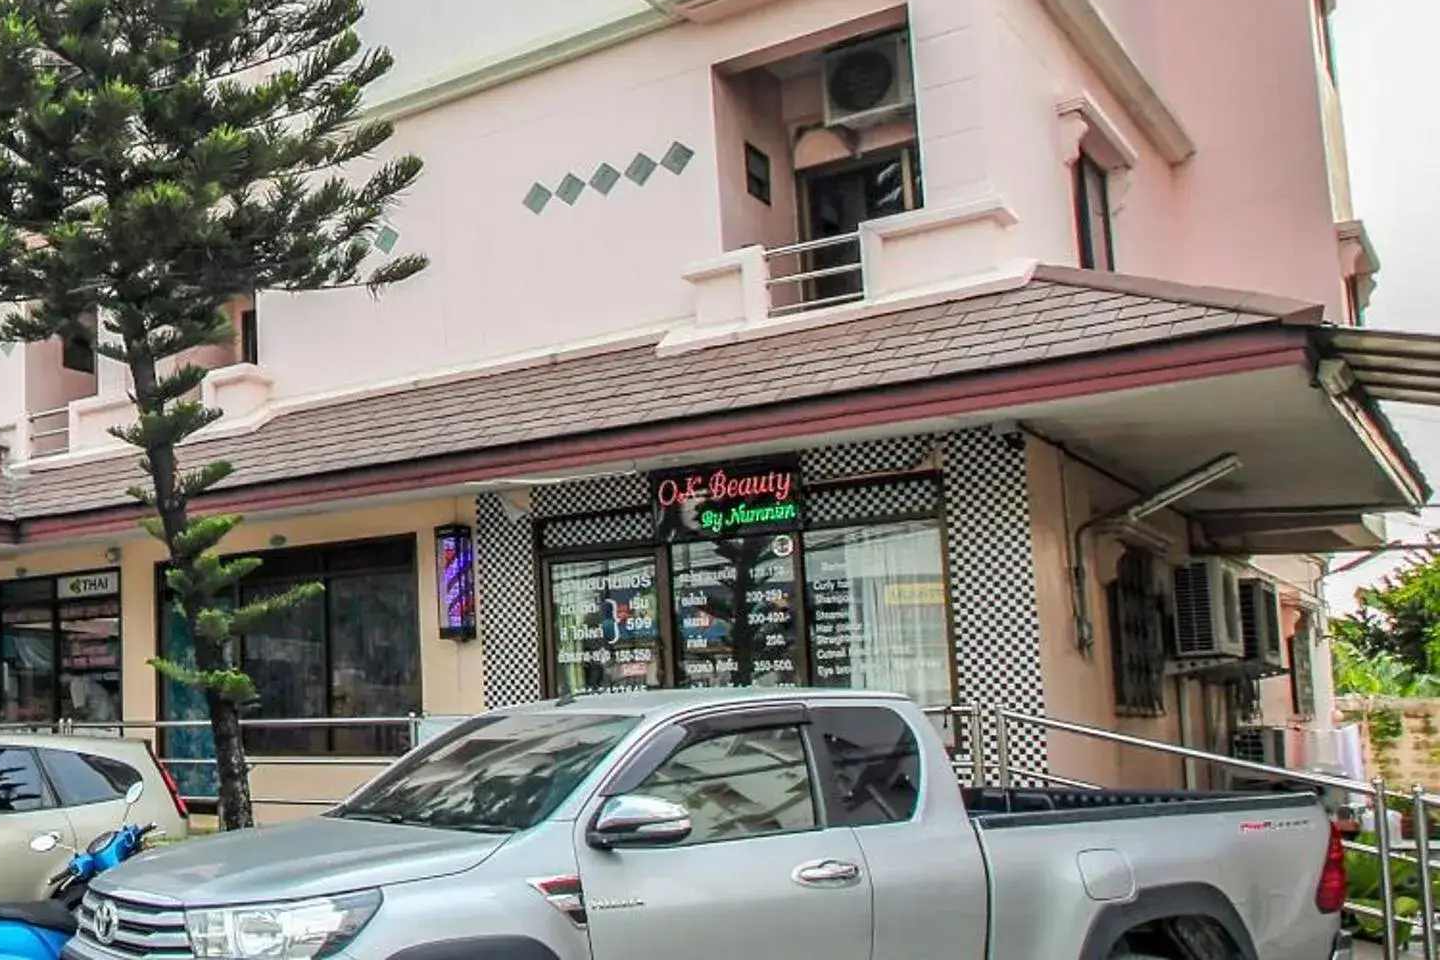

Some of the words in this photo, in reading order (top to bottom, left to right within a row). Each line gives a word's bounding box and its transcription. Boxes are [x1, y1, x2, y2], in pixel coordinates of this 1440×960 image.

[709, 468, 792, 502] Beauty
[701, 510, 724, 533] By
[82, 576, 109, 592] THAI
